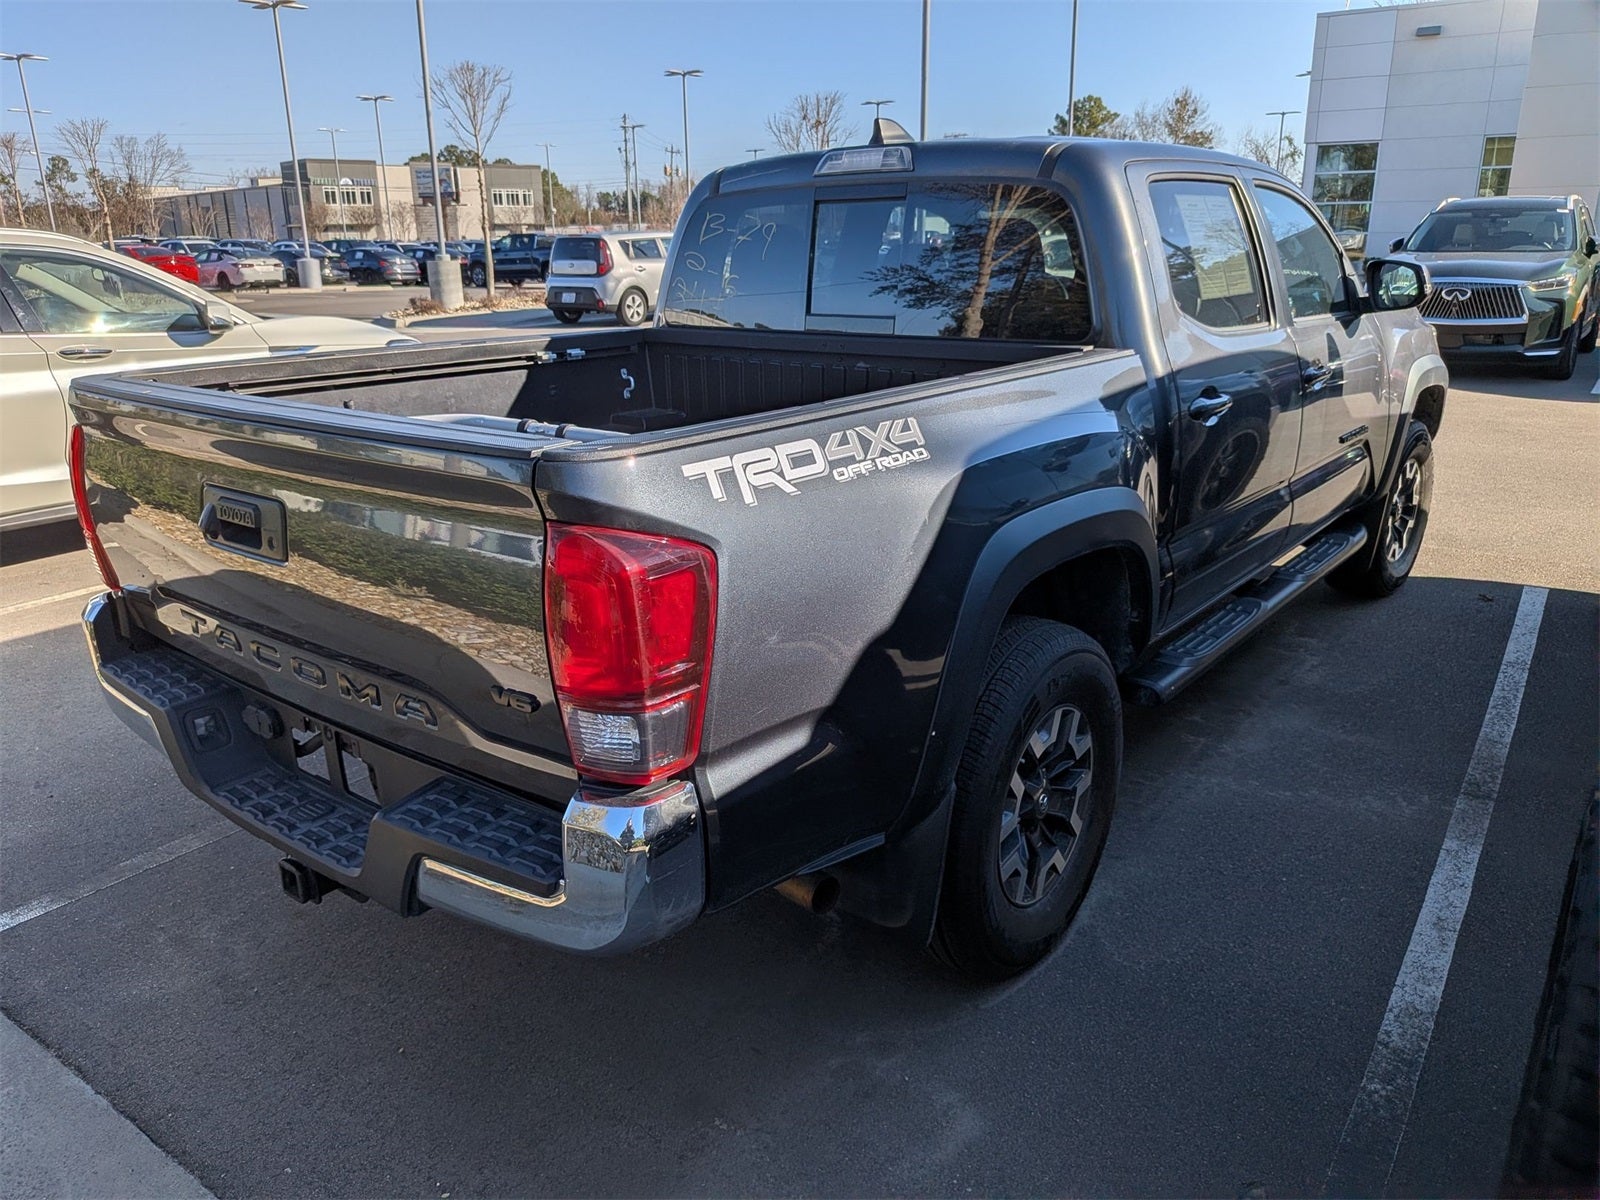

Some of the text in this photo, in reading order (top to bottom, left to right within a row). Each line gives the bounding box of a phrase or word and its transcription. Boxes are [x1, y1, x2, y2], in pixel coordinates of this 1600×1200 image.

[681, 417, 926, 507] TRD 4X4
[832, 447, 931, 483] OFF ROAD
[219, 505, 255, 526] TOYOTA
[179, 607, 439, 731] TACOMA
[490, 684, 542, 714] V6
